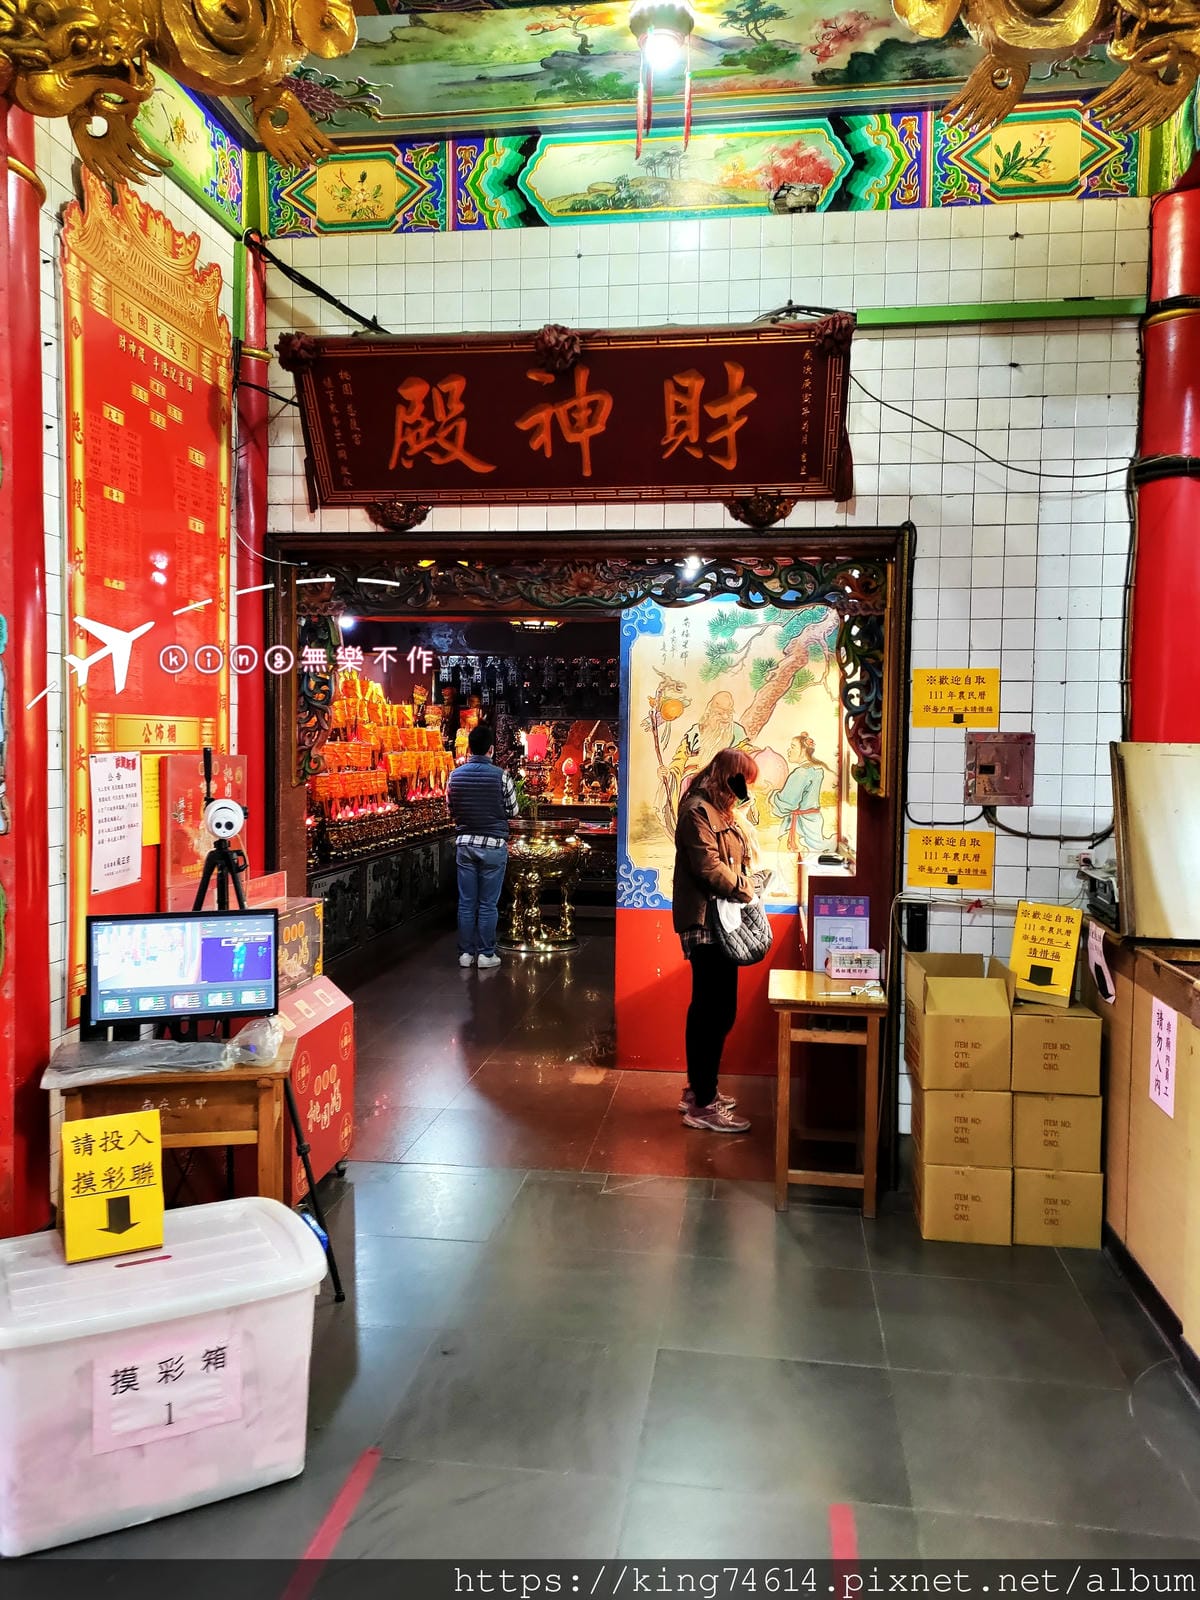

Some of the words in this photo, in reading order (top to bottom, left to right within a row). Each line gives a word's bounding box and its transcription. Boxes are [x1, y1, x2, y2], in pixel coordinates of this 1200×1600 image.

[120, 301, 190, 361] 桃園慈護宮
[388, 360, 758, 478] 財神殿
[142, 723, 177, 744] 公佈欄
[70, 1129, 154, 1157] 請投入
[70, 1161, 155, 1195] 摸彩聯
[110, 1345, 230, 1396] 摸彩箱
[163, 1402, 175, 1426] 1
